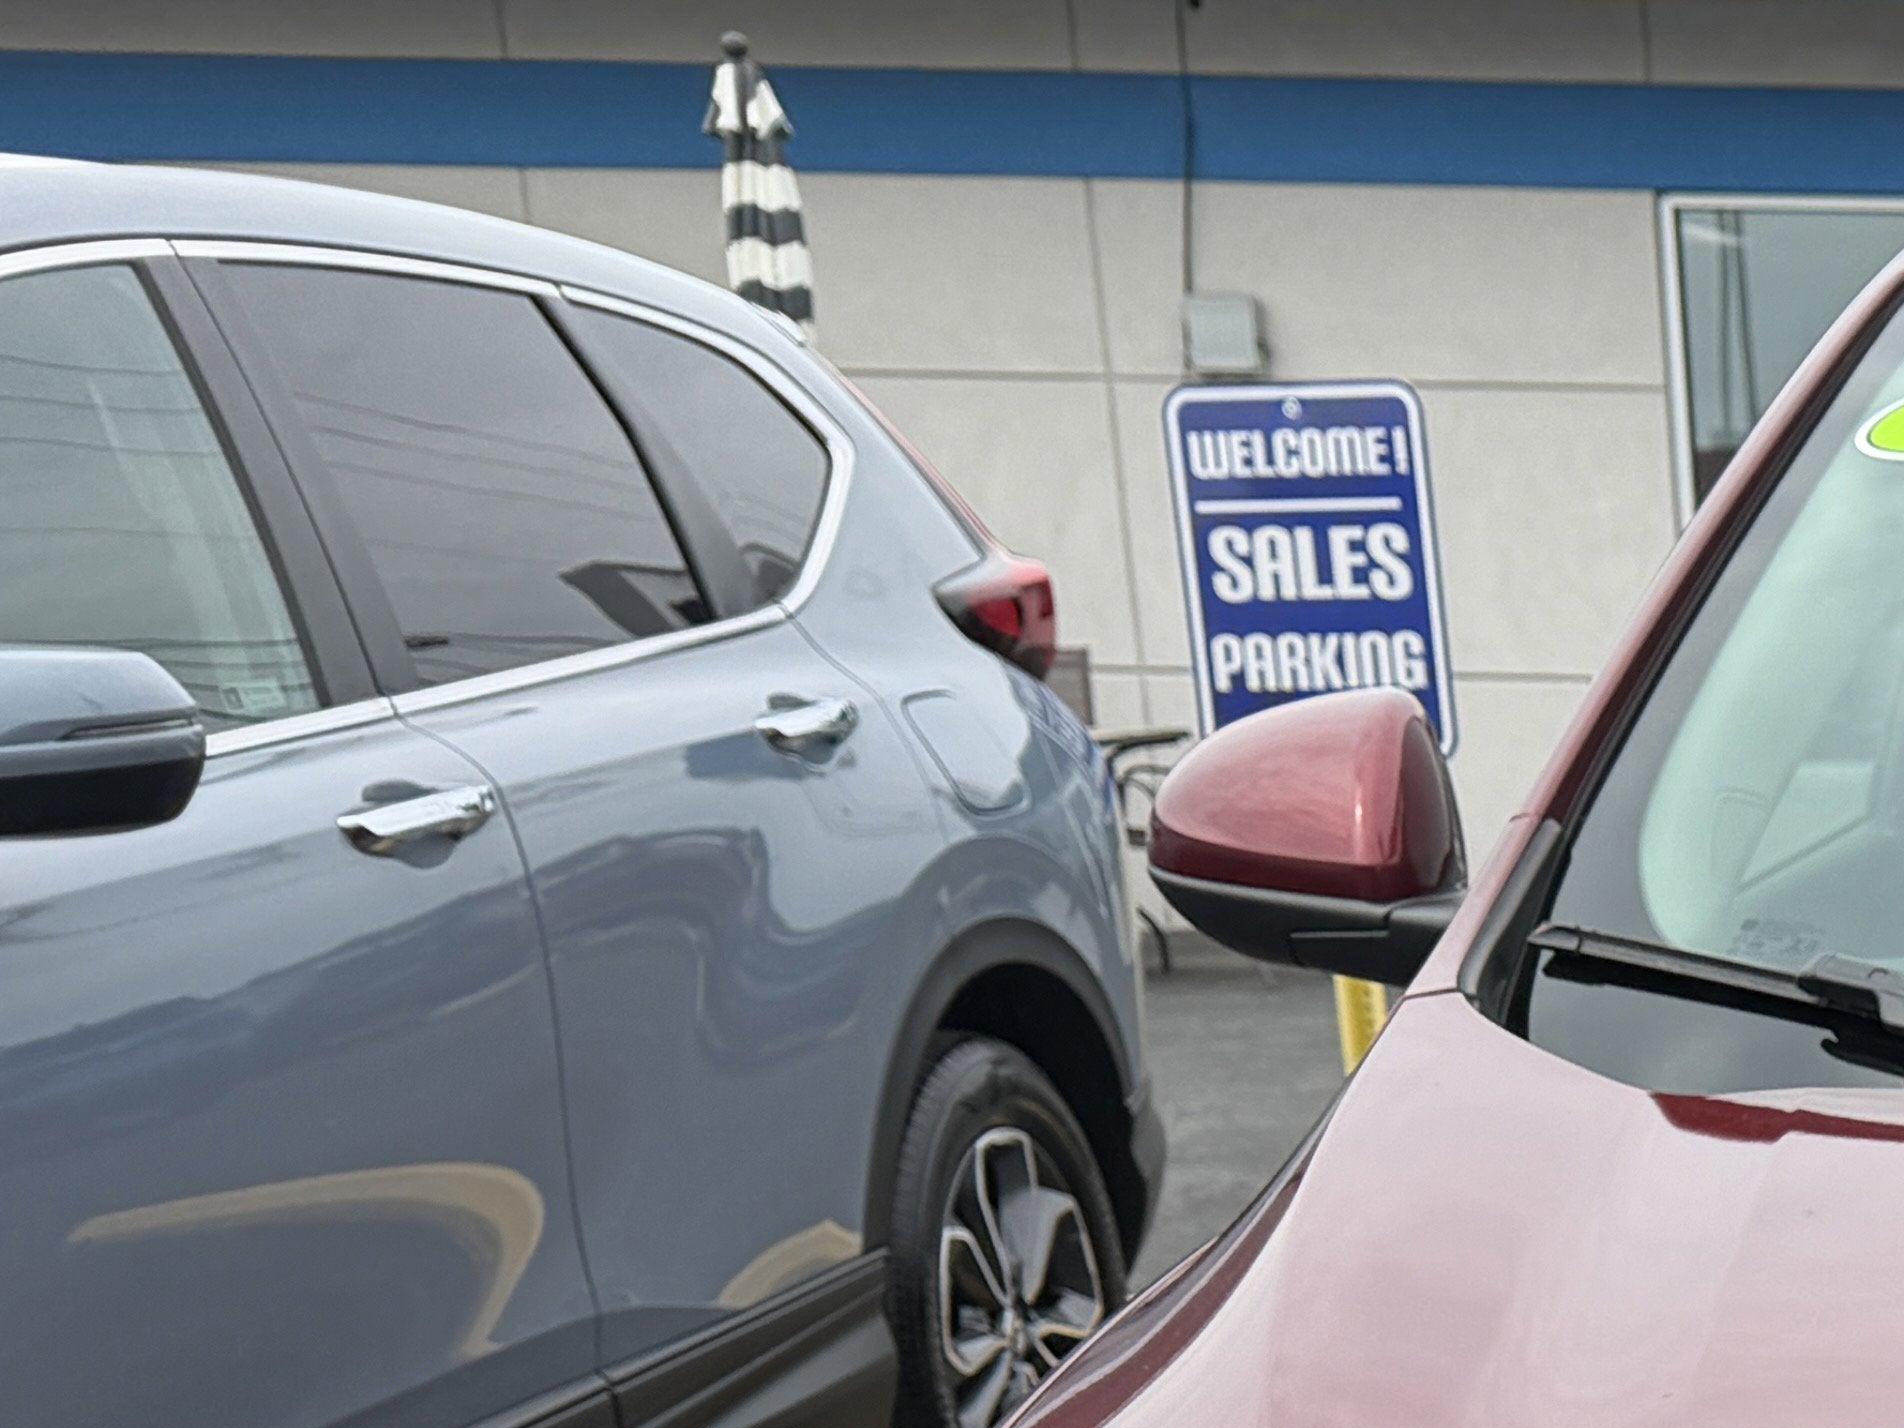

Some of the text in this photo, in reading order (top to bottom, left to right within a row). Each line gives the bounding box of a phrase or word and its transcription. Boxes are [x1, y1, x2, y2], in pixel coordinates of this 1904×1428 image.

[1187, 425, 1411, 480] WELCOME!
[1207, 522, 1415, 604] SALES
[1209, 629, 1430, 694] PARKING
